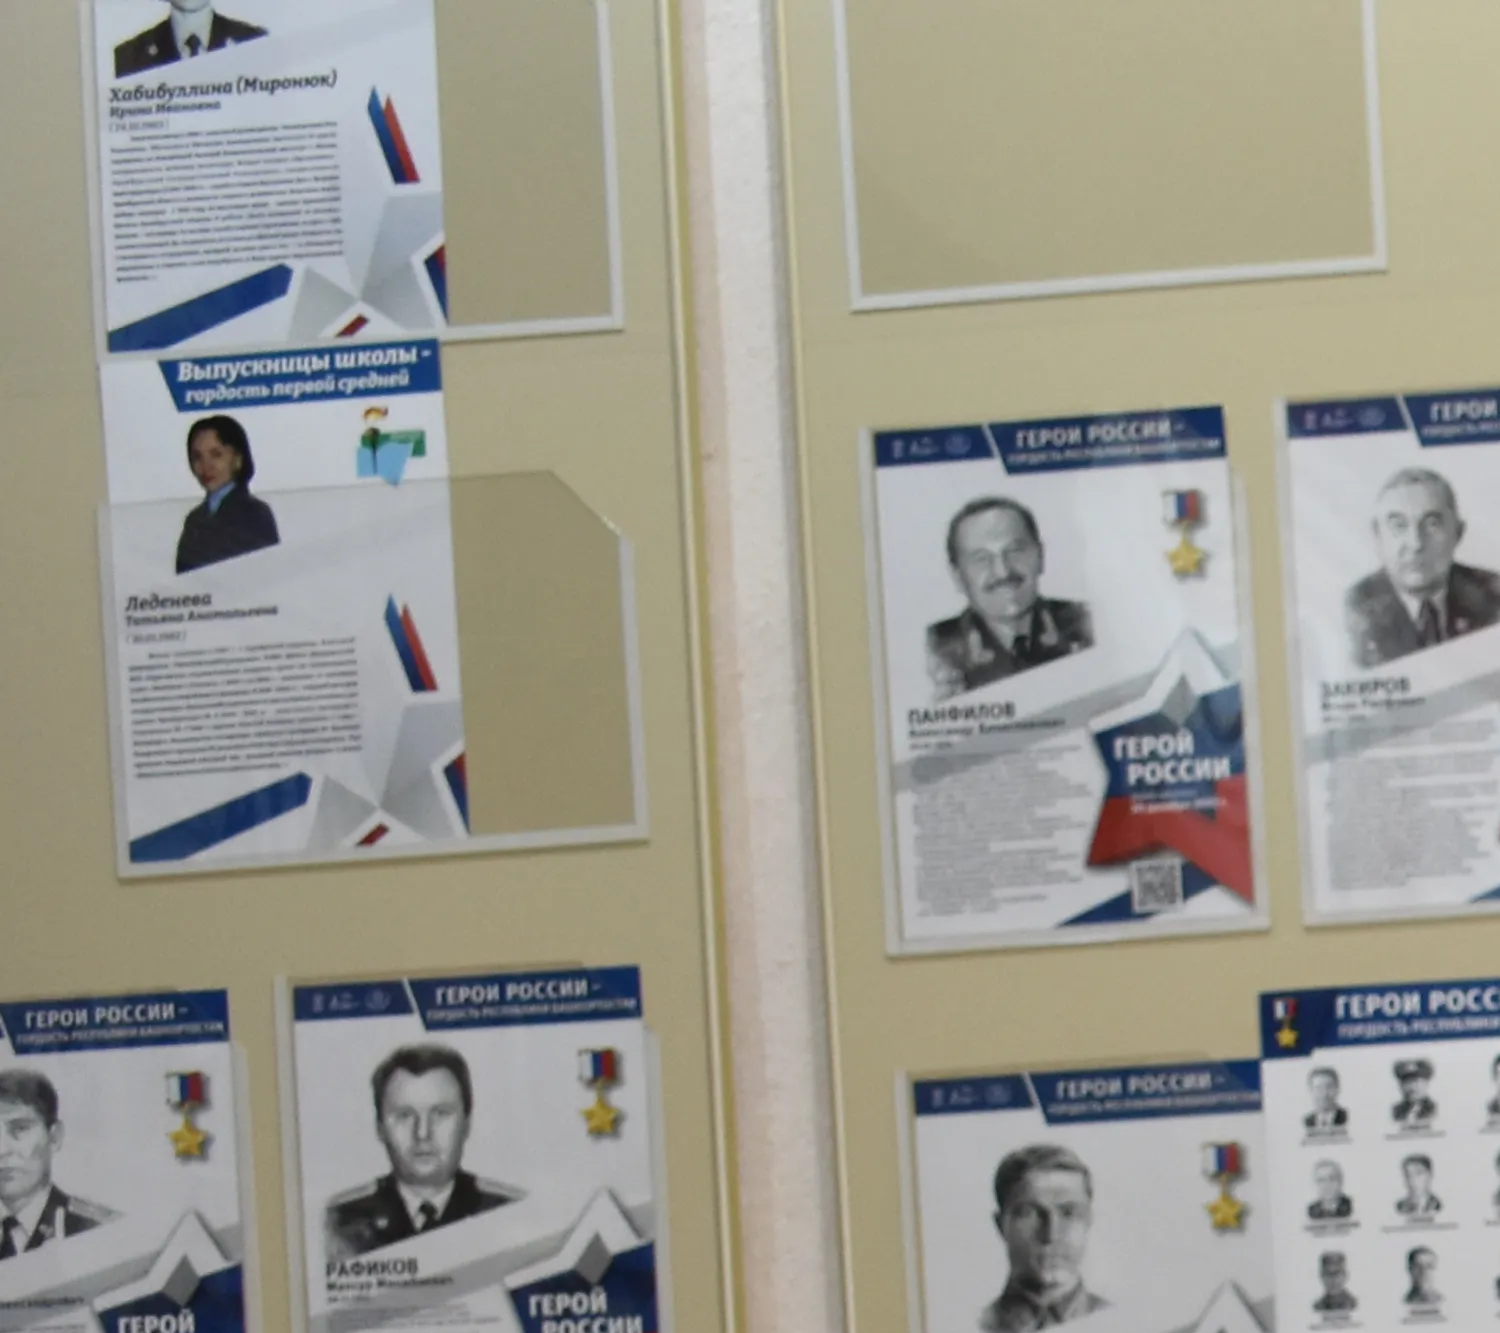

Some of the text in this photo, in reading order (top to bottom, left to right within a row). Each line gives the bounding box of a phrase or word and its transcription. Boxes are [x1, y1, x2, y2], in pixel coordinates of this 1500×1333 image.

[109, 69, 338, 103] Хабибуллина (Миронюк)
[178, 353, 331, 384] Выпускницы
[334, 346, 418, 369] школы
[186, 370, 410, 404] гордость первой средней
[1430, 398, 1498, 423] ГЕРОИ
[1016, 418, 1172, 449] ГЕРОИ РОССИИ
[908, 702, 1016, 726] ПАНФИЛОВ
[1113, 730, 1195, 762] ГЕРОЙ
[1127, 756, 1231, 787] РОССИИ
[435, 977, 588, 1007] ГЕРОИ РОССИИ
[1335, 993, 1421, 1020] ГЕРОИ
[25, 1003, 175, 1030] ГЕРОИ РОССИИ
[1127, 1072, 1213, 1095] РОССИИ
[326, 1258, 419, 1278] РАФИКОВ
[529, 1286, 607, 1318] ГЕРОЙ
